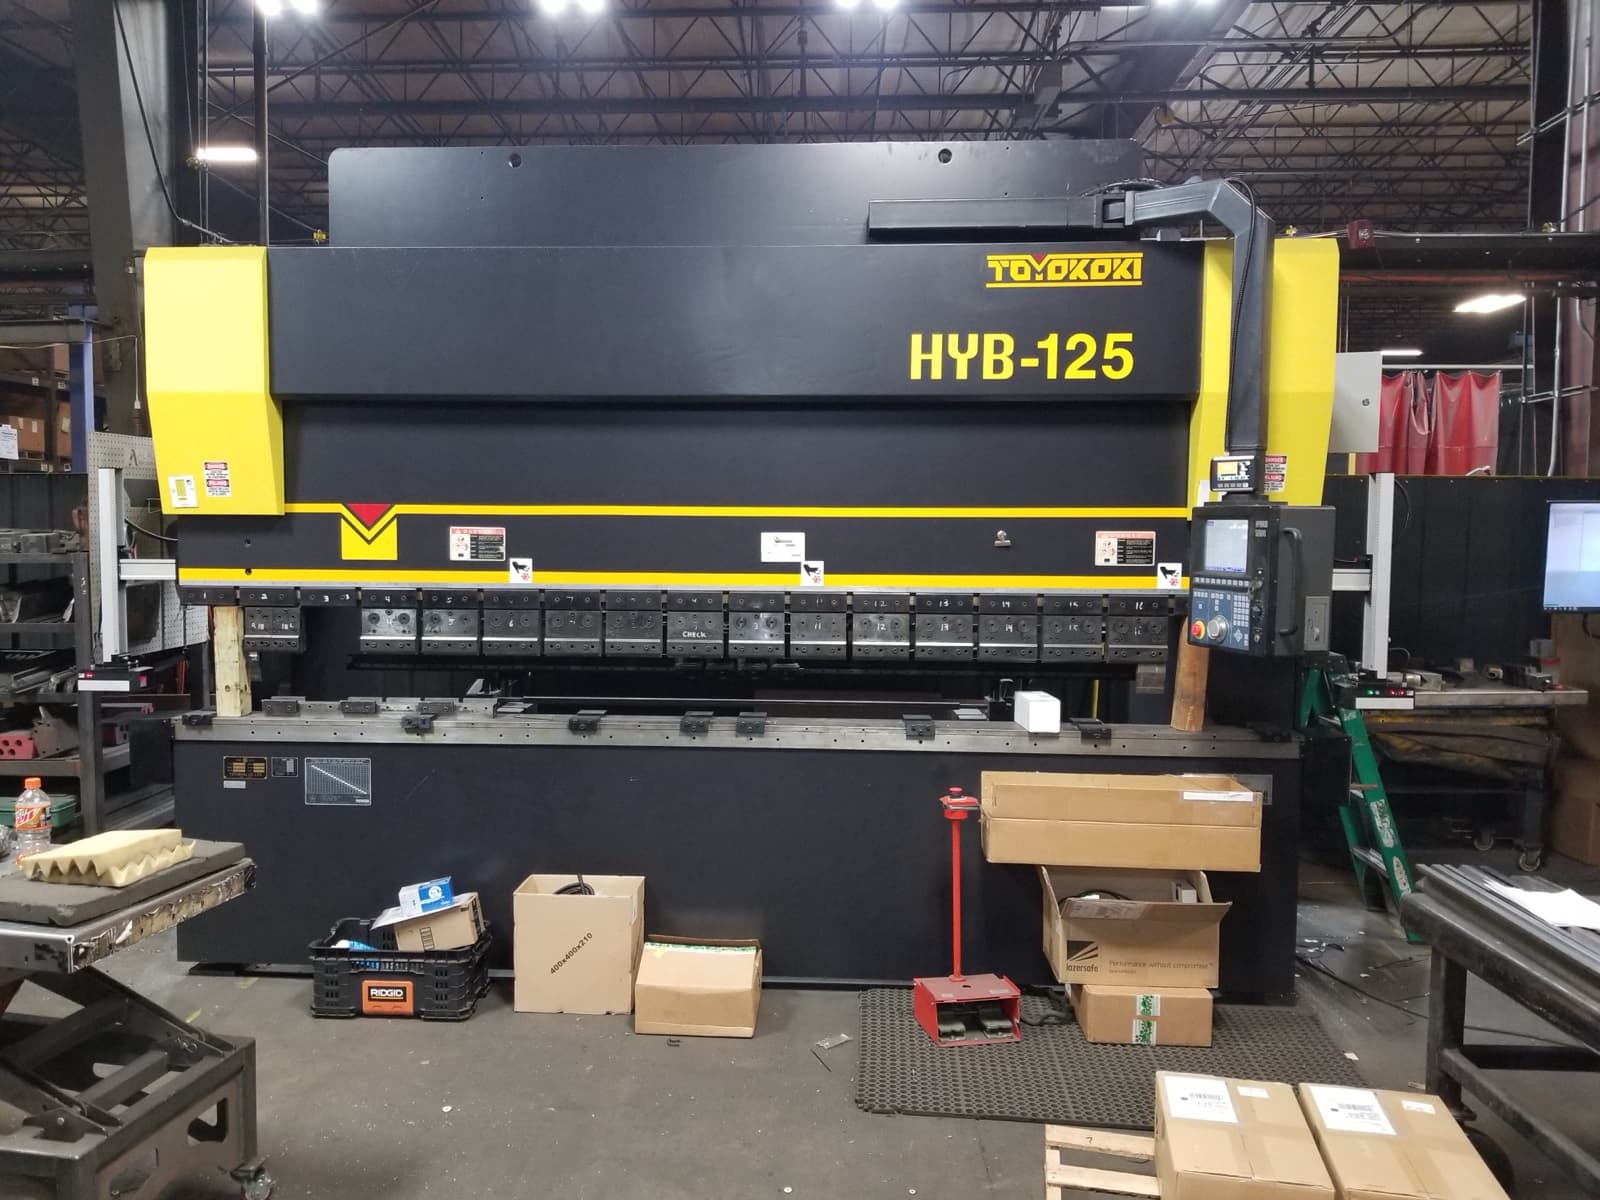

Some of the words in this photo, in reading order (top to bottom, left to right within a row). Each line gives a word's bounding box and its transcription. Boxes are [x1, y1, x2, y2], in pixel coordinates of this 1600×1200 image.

[987, 254, 1142, 282] TOYOKOKI
[910, 333, 1134, 380] HYB-125
[877, 623, 886, 631] 12
[549, 932, 593, 974] 400x400x210
[1066, 962, 1099, 973] lazersafe
[370, 988, 404, 997] RIDGID
